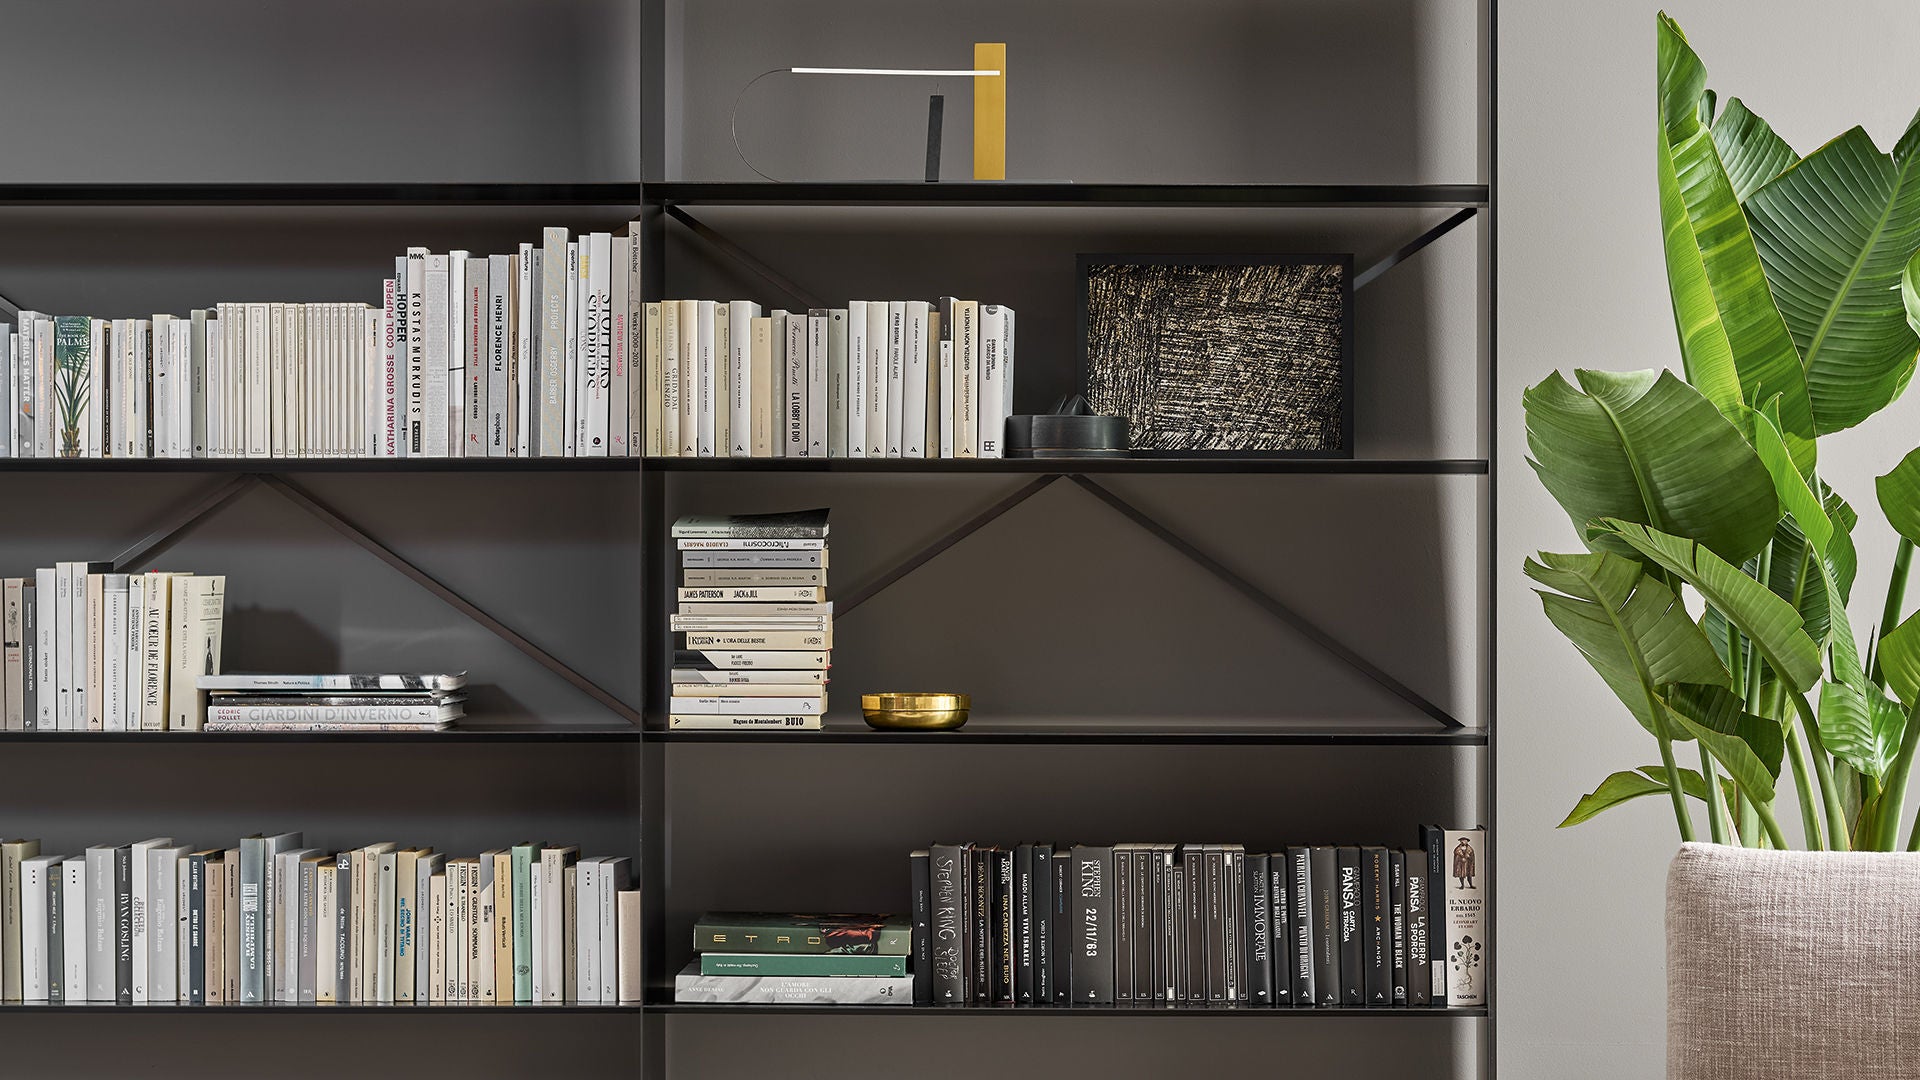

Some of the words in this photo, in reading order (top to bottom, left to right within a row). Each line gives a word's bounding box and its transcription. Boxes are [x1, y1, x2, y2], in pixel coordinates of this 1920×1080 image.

[386, 280, 394, 319] PUPPEN
[397, 293, 406, 342] HOPPER
[412, 293, 421, 342] KOSTAS
[22, 318, 31, 366] MATERIALS
[57, 337, 89, 346] PALMS
[386, 322, 394, 349] COOL
[791, 321, 801, 357] Ferruccio
[386, 354, 394, 394] GROSSE
[616, 342, 624, 377] WILLIAMSON
[791, 358, 801, 386] Pinotti
[23, 368, 31, 402] MATTER
[412, 346, 421, 414] MURKUDIS
[791, 392, 800, 401] LA
[387, 398, 395, 455] KATHARINA
[791, 402, 800, 421] LOBBY
[791, 431, 800, 442] DIO
[683, 591, 699, 599] JAMES
[149, 607, 159, 618] AU
[148, 650, 158, 661] DE
[147, 662, 158, 706] FLORENCE
[250, 708, 320, 721] GIARDINI
[324, 708, 412, 721] D'INVERNO
[785, 717, 804, 726] BUIO
[936, 856, 954, 903] STEPHEN
[1081, 859, 1094, 897] KING
[1093, 859, 1101, 898] STEPHEN
[1296, 854, 1305, 884] PATRICIA
[1297, 884, 1306, 918] CORNWELL
[1342, 867, 1353, 909] PANSA
[1409, 876, 1419, 912] PANSA
[95, 898, 104, 927] Eugenio
[120, 893, 129, 917] RYAN
[936, 907, 956, 940] KING
[979, 919, 984, 927] LA
[1085, 908, 1097, 956] 22/11/'63
[1254, 894, 1266, 962] IMMORTALE
[1298, 926, 1308, 946] PUNTO
[1394, 916, 1402, 940] WOMAN
[1418, 916, 1425, 928] LA
[120, 919, 130, 961] GOSLING
[713, 934, 821, 945] ETRO
[1410, 923, 1418, 959] SPORCA
[1418, 929, 1426, 966] GUERRA
[934, 947, 949, 980] SLEEP
[947, 947, 959, 980] DOCTOR
[1299, 954, 1309, 979] ORIGINE
